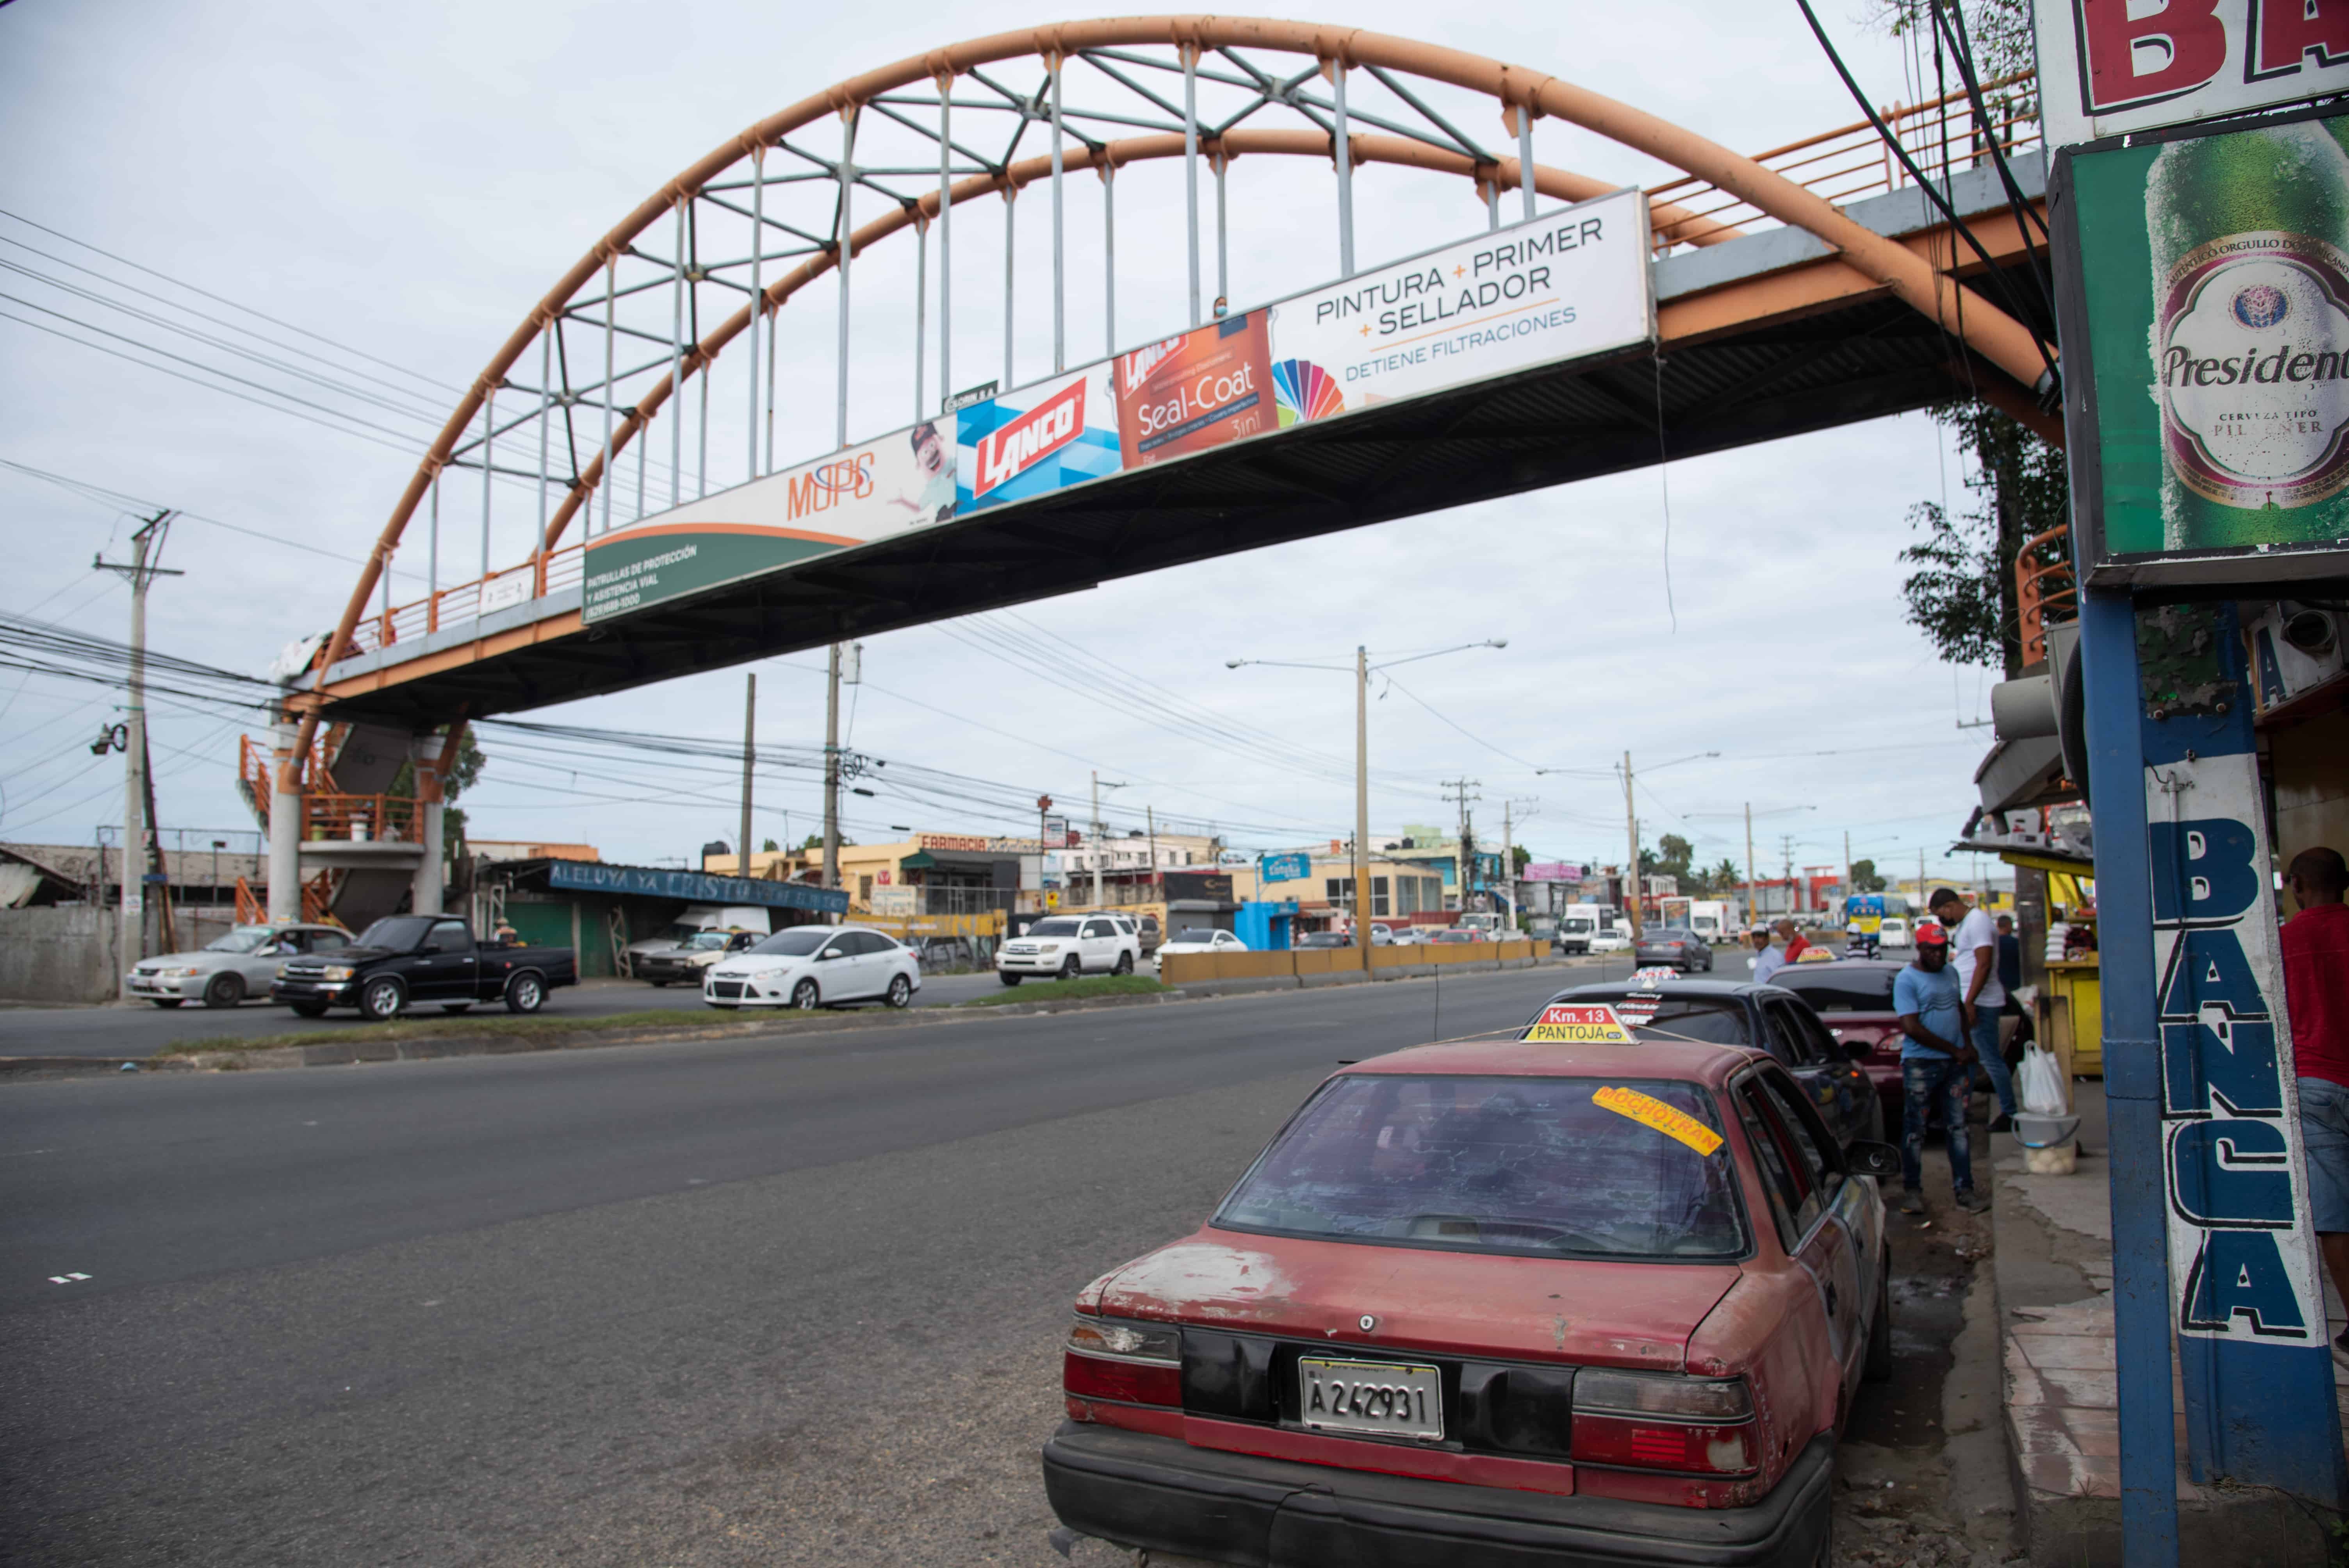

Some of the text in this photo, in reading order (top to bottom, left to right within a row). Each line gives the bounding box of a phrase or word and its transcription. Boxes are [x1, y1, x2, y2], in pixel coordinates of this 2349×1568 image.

[1317, 268, 1444, 324] PINTURA
[1474, 217, 1603, 278] PRIMER
[2219, 239, 2279, 254] ORGULLO
[2282, 240, 2349, 274] DONICANO
[1379, 266, 1551, 335] SELLADOR
[1346, 306, 1577, 382] DETIENE FILTRACIONES
[1138, 362, 1254, 436] Seal-Coat
[2285, 410, 2317, 419] TIPO
[984, 397, 1075, 487] LANCO
[2214, 421, 2324, 436] PILER
[788, 451, 874, 521] MOPC
[587, 544, 697, 589] PATRULLAS DE PROTECCIÓN
[639, 573, 659, 588] VIAL
[922, 836, 986, 852] FARMACIA
[551, 864, 628, 887] ALELUYA
[637, 872, 658, 890] YA
[1537, 1026, 1605, 1039] PANTOJA
[1549, 1009, 1581, 1023] Km.
[1585, 1009, 1605, 1023] 13
[2148, 817, 2307, 1338] BANCA
[1598, 1086, 1718, 1149] MOCHOTRAN
